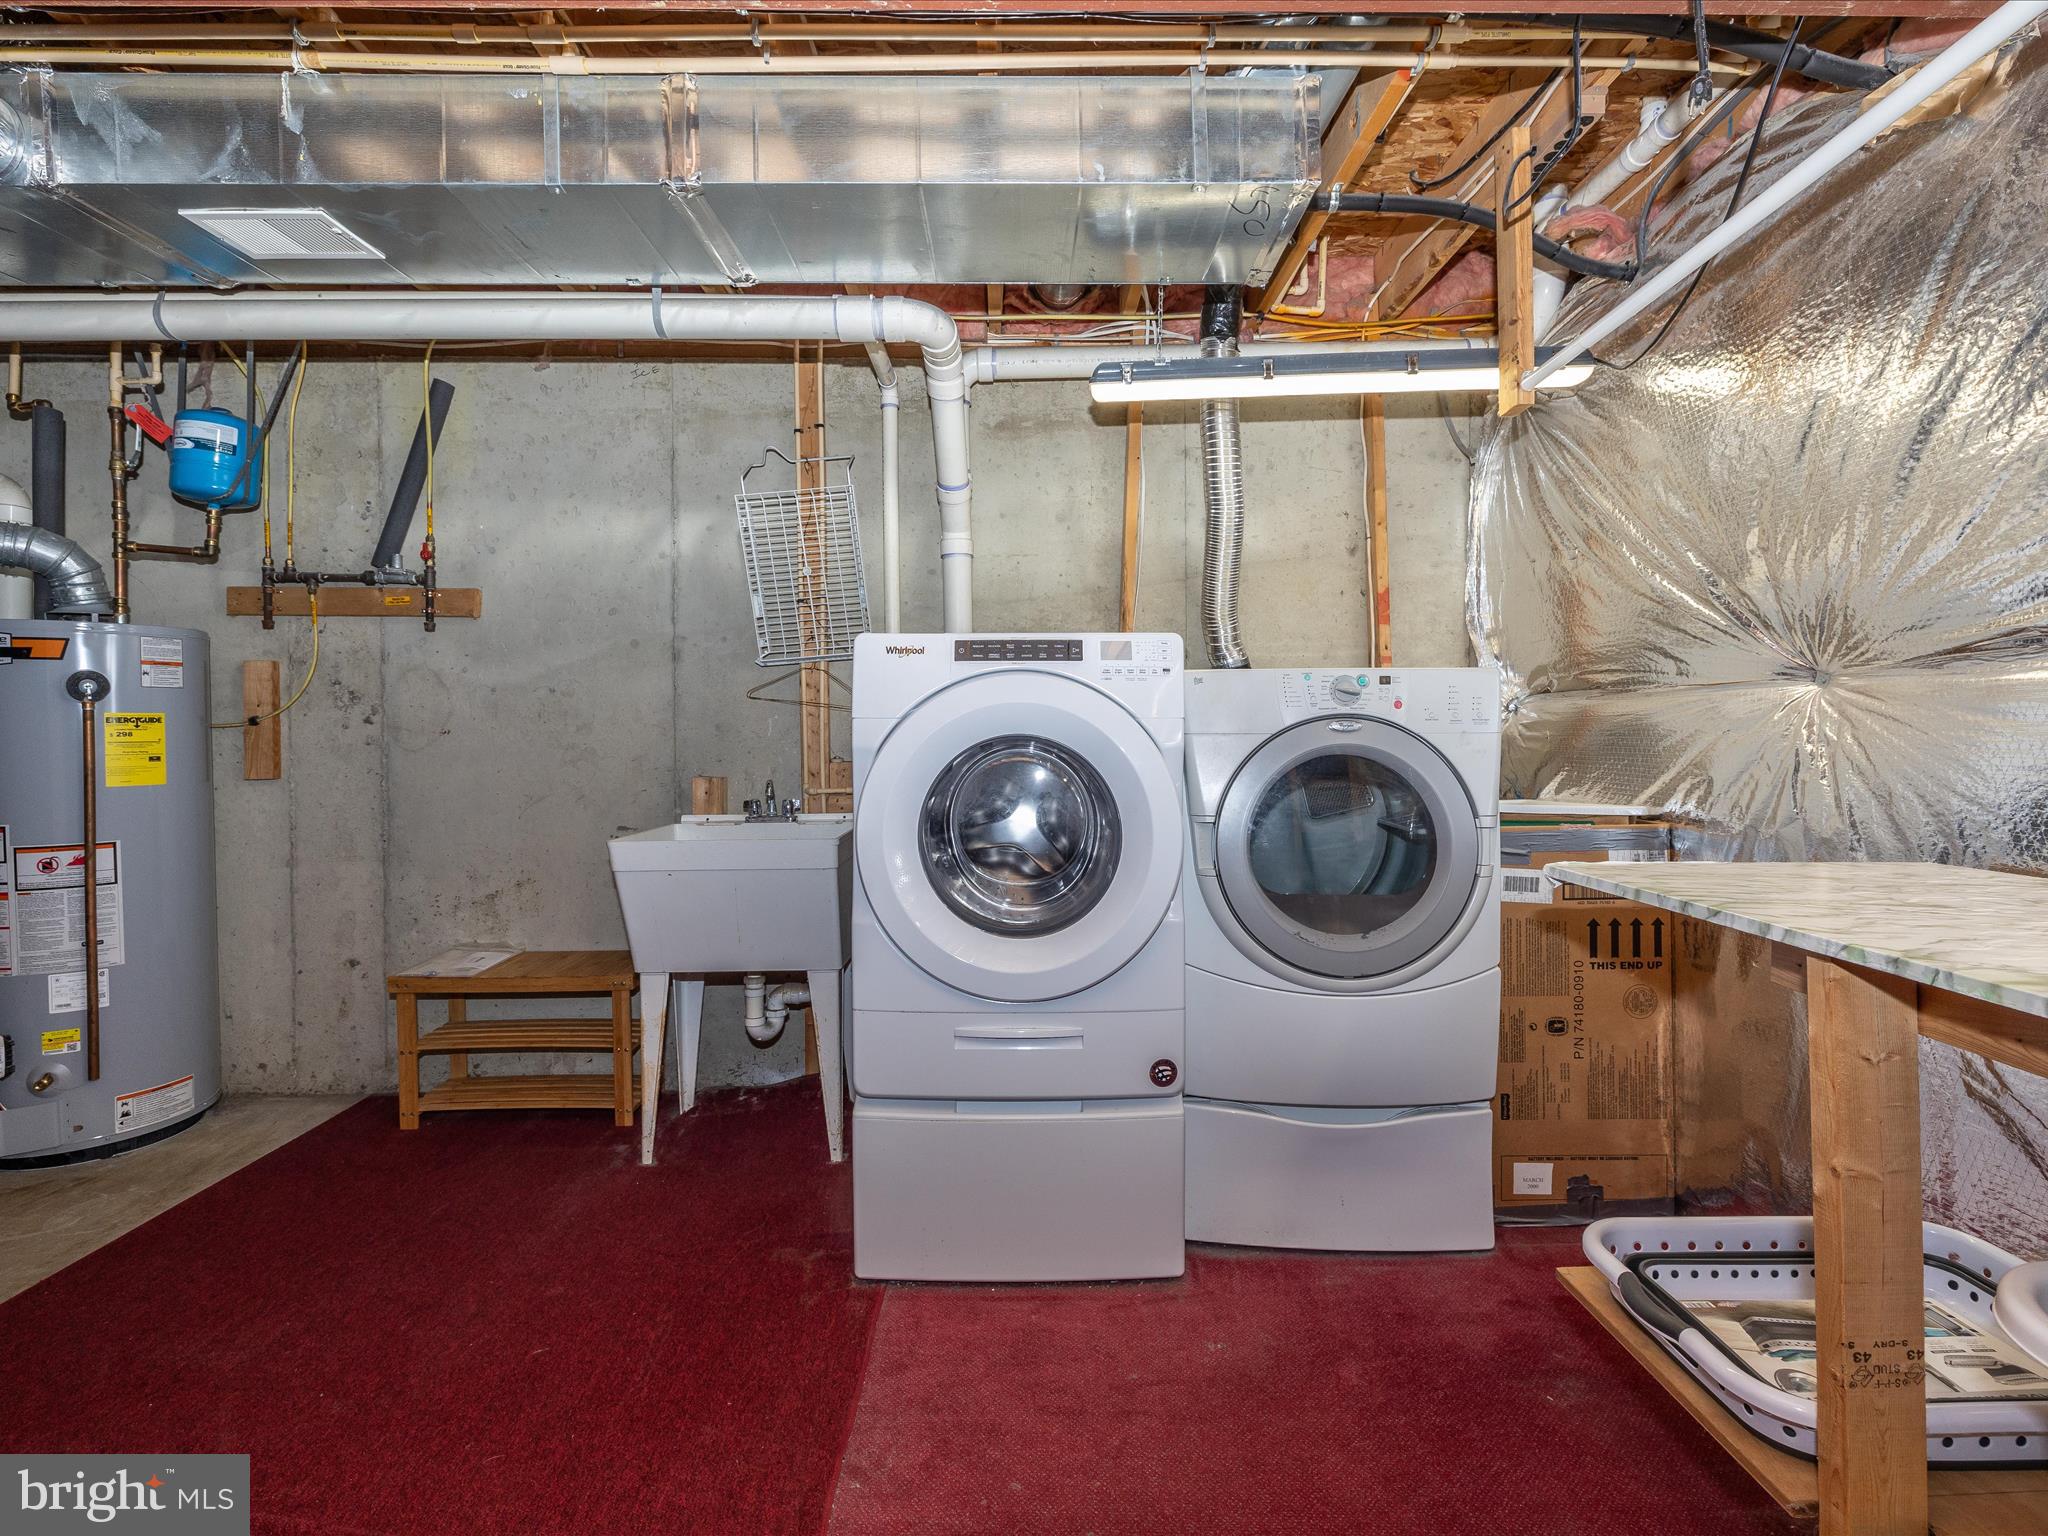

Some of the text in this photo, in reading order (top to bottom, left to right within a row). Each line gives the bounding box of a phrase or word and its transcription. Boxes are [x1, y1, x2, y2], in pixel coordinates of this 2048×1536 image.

[886, 646, 924, 658] Whirlpool
[1589, 961, 1663, 970] THIS END UP
[1573, 960, 1584, 1060] P/N 74180-0910
[1873, 1339, 1908, 1349] S-DRY
[1853, 1351, 1872, 1363] 43
[1907, 1349, 1924, 1361] 43
[1873, 1364, 1901, 1375] STUD
